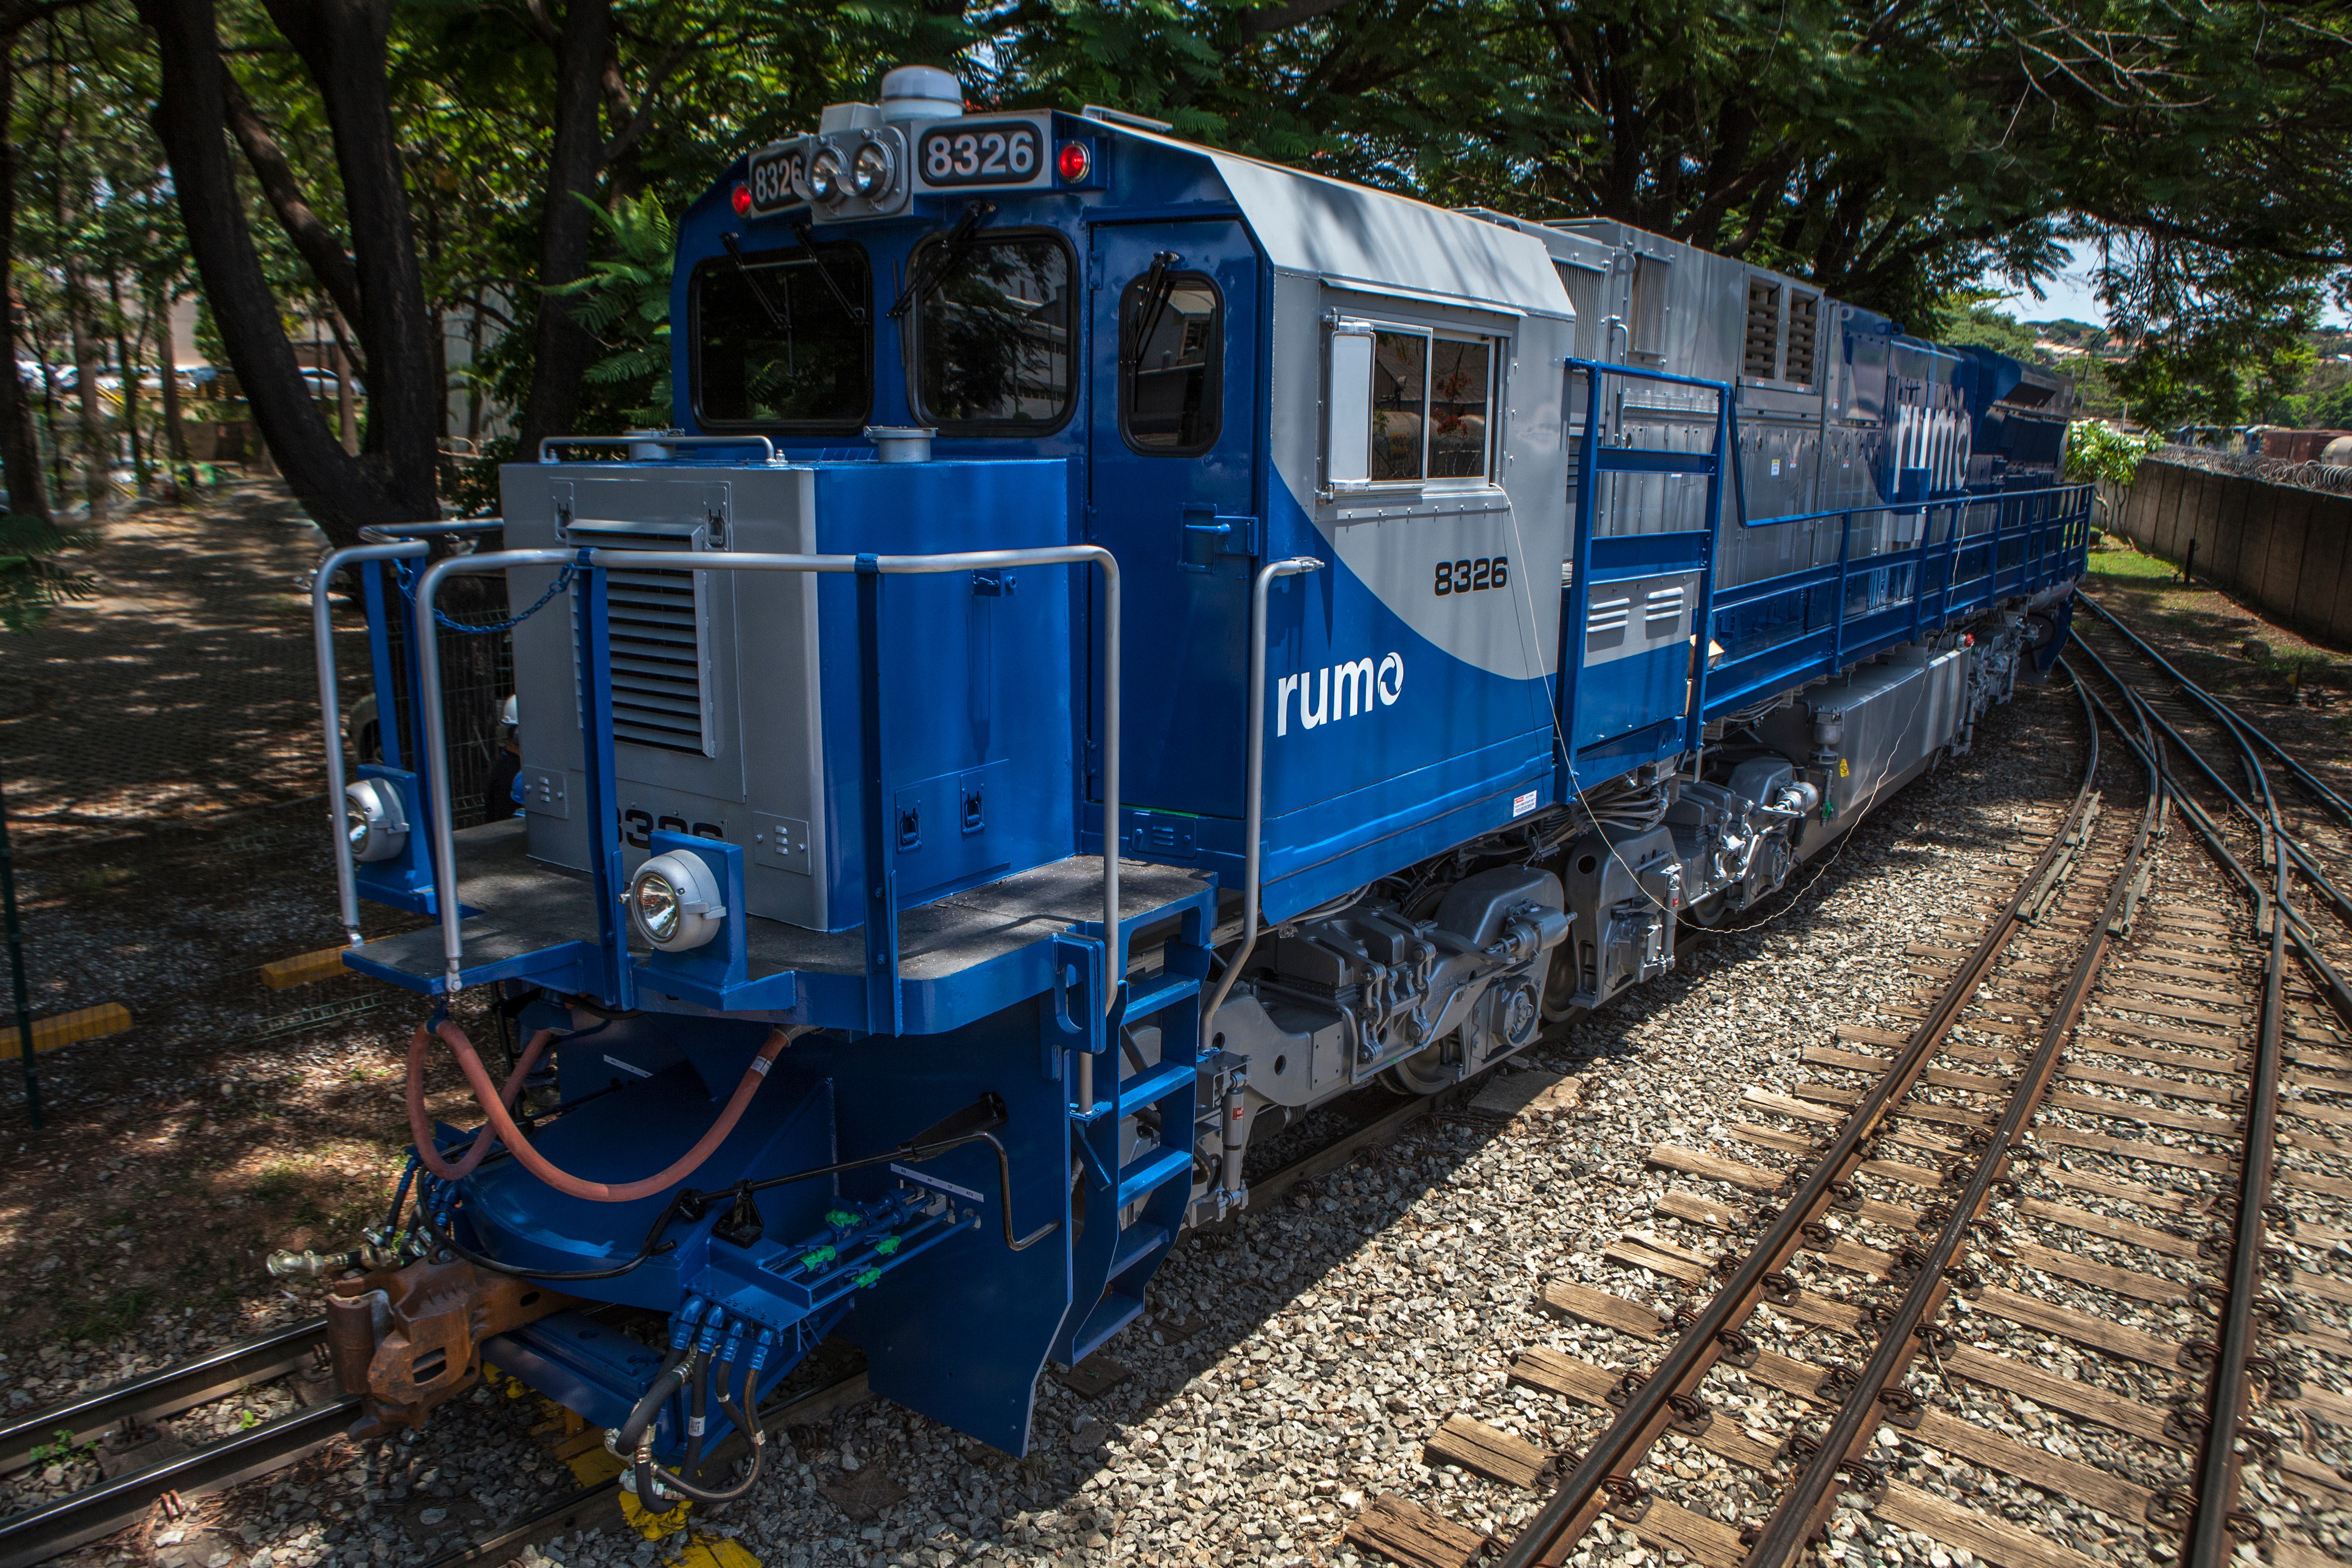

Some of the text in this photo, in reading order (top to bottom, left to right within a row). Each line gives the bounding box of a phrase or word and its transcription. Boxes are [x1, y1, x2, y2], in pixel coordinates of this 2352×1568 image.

[928, 131, 1034, 178] 8326
[756, 155, 803, 203] 8326
[1893, 404, 1971, 493] rumo
[1434, 556, 1507, 596] 8326
[1277, 652, 1404, 737] rumo
